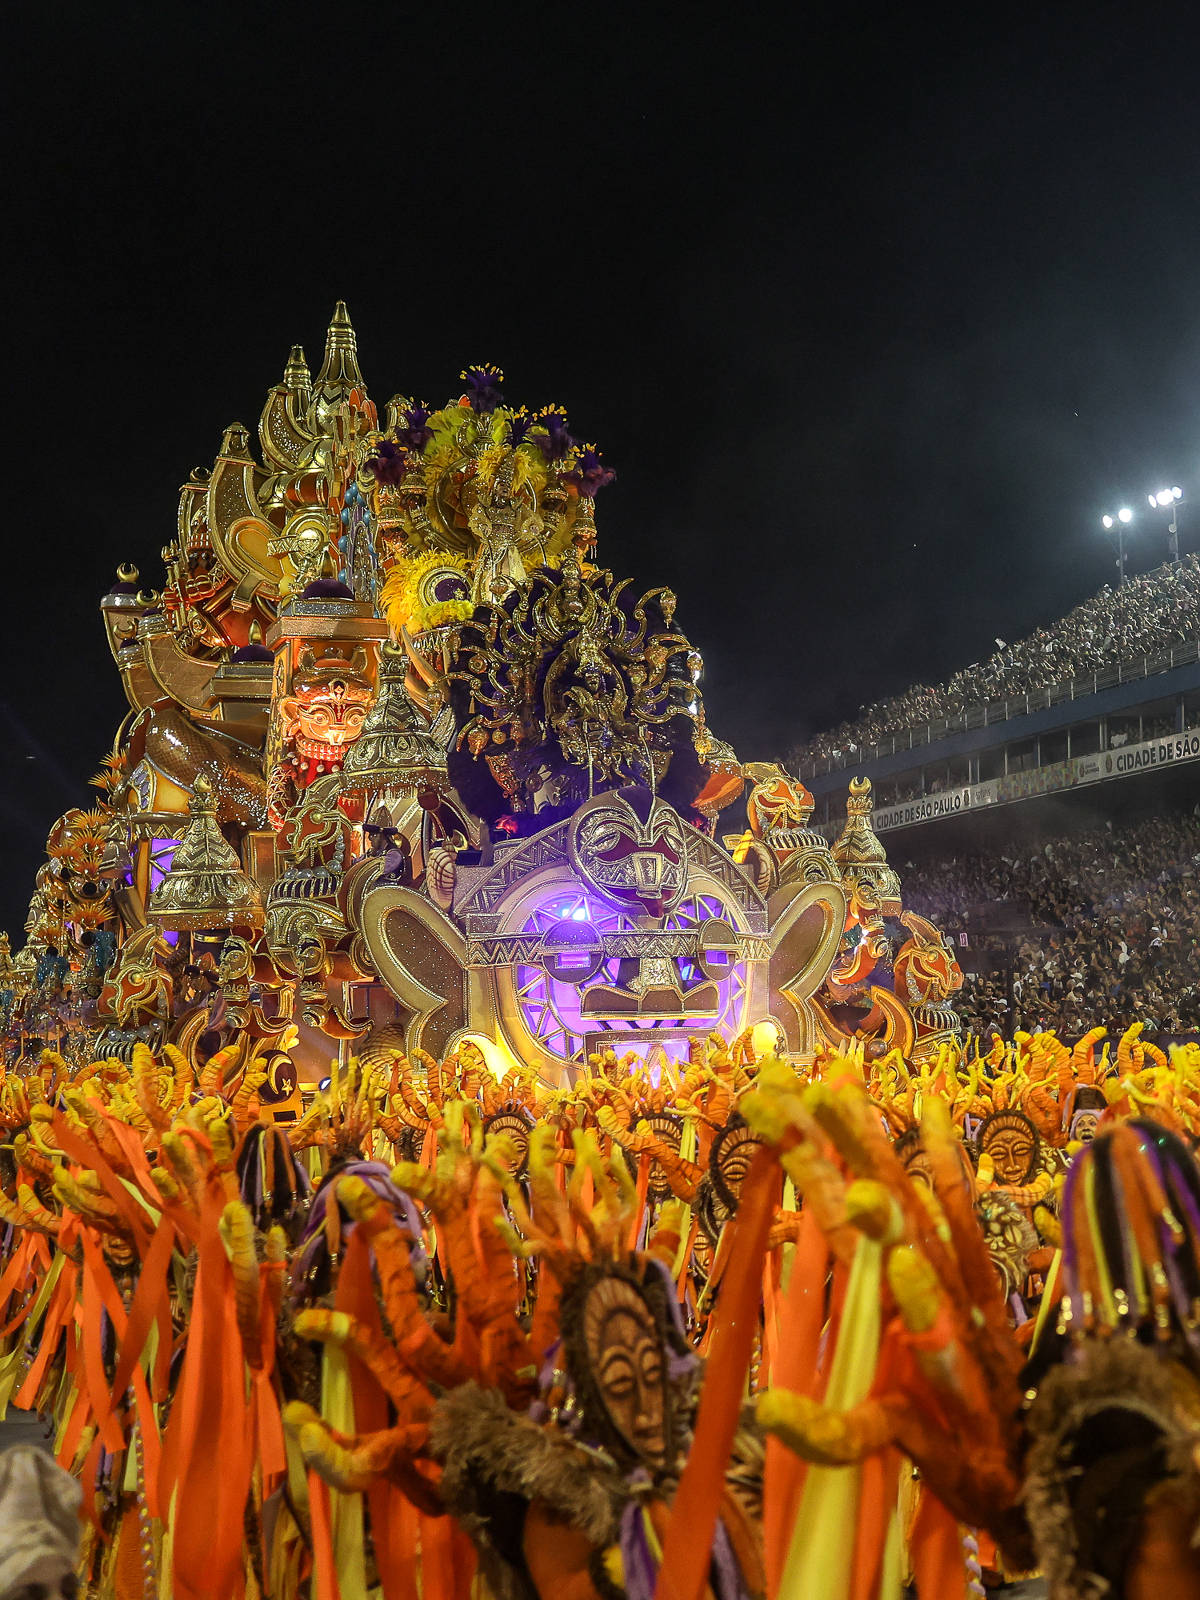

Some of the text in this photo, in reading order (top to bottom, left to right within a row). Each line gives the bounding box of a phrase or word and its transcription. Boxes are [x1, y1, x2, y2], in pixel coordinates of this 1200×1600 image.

[1117, 747, 1156, 771] CIDADE
[1159, 743, 1173, 763] DE
[1176, 734, 1199, 758] SÃO
[876, 794, 961, 828] CIDADE DE SÃO PAULO
